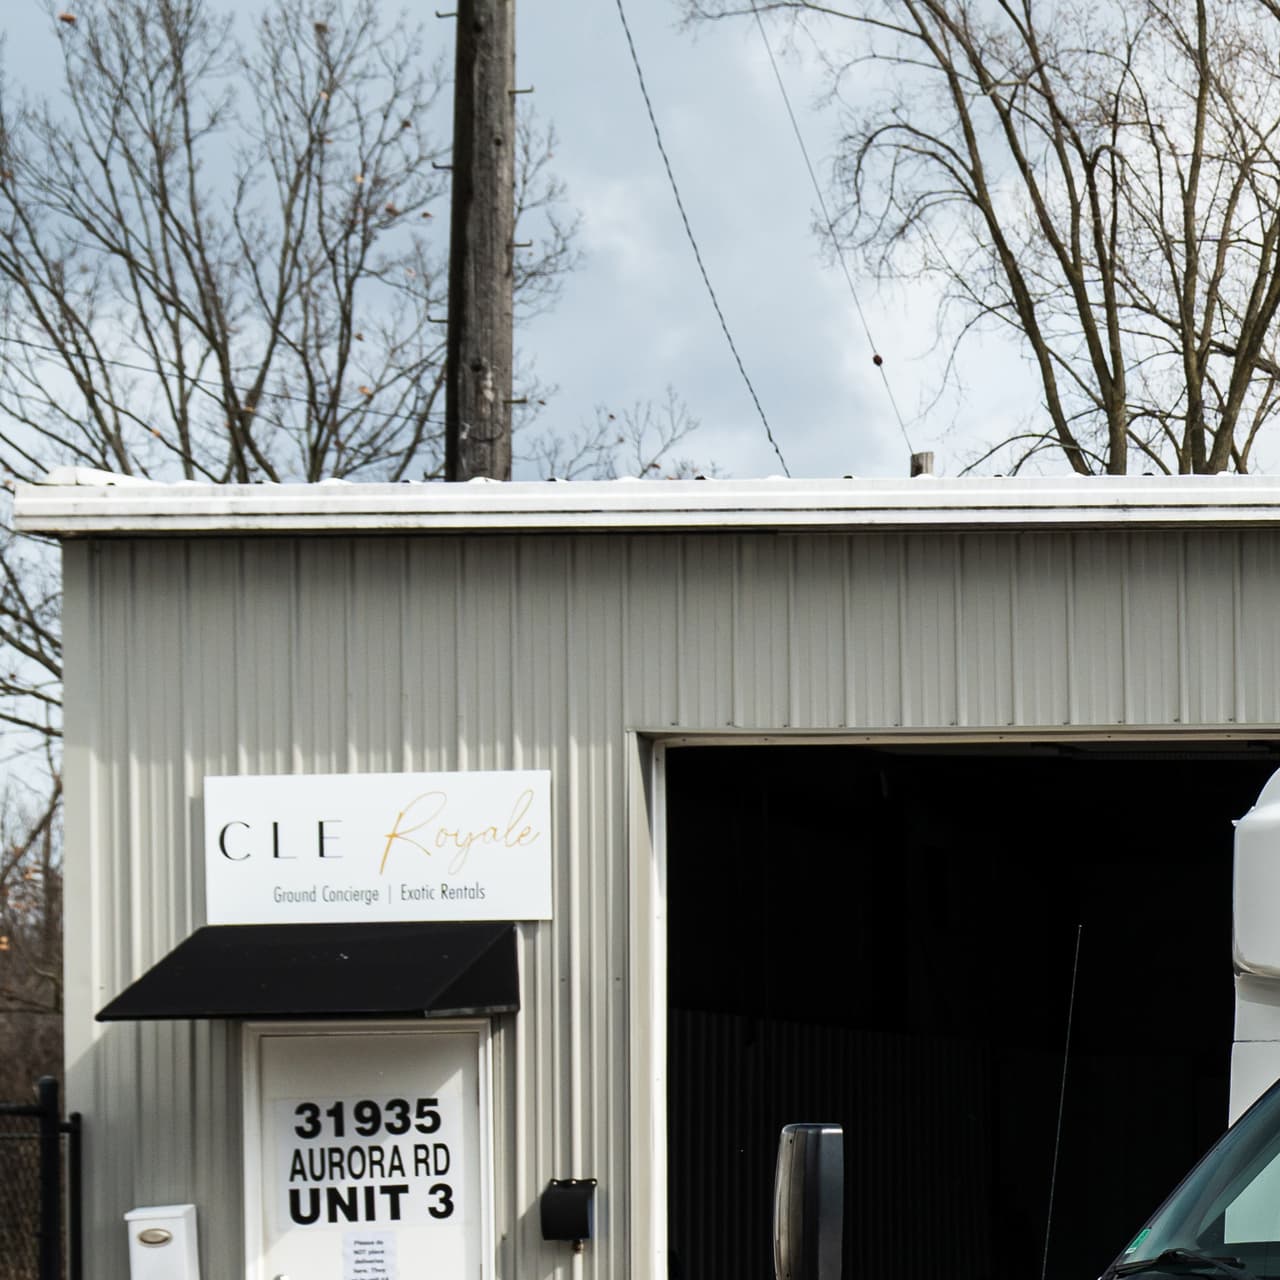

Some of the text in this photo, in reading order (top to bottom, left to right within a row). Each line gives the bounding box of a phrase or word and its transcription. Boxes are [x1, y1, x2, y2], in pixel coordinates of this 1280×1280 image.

[379, 788, 541, 876] Royale
[273, 881, 486, 906] Ground Concierge Exotic Rentals
[294, 1097, 442, 1139] 31935
[289, 1142, 451, 1182] AURORA RD
[288, 1182, 455, 1225] UNIT 3
